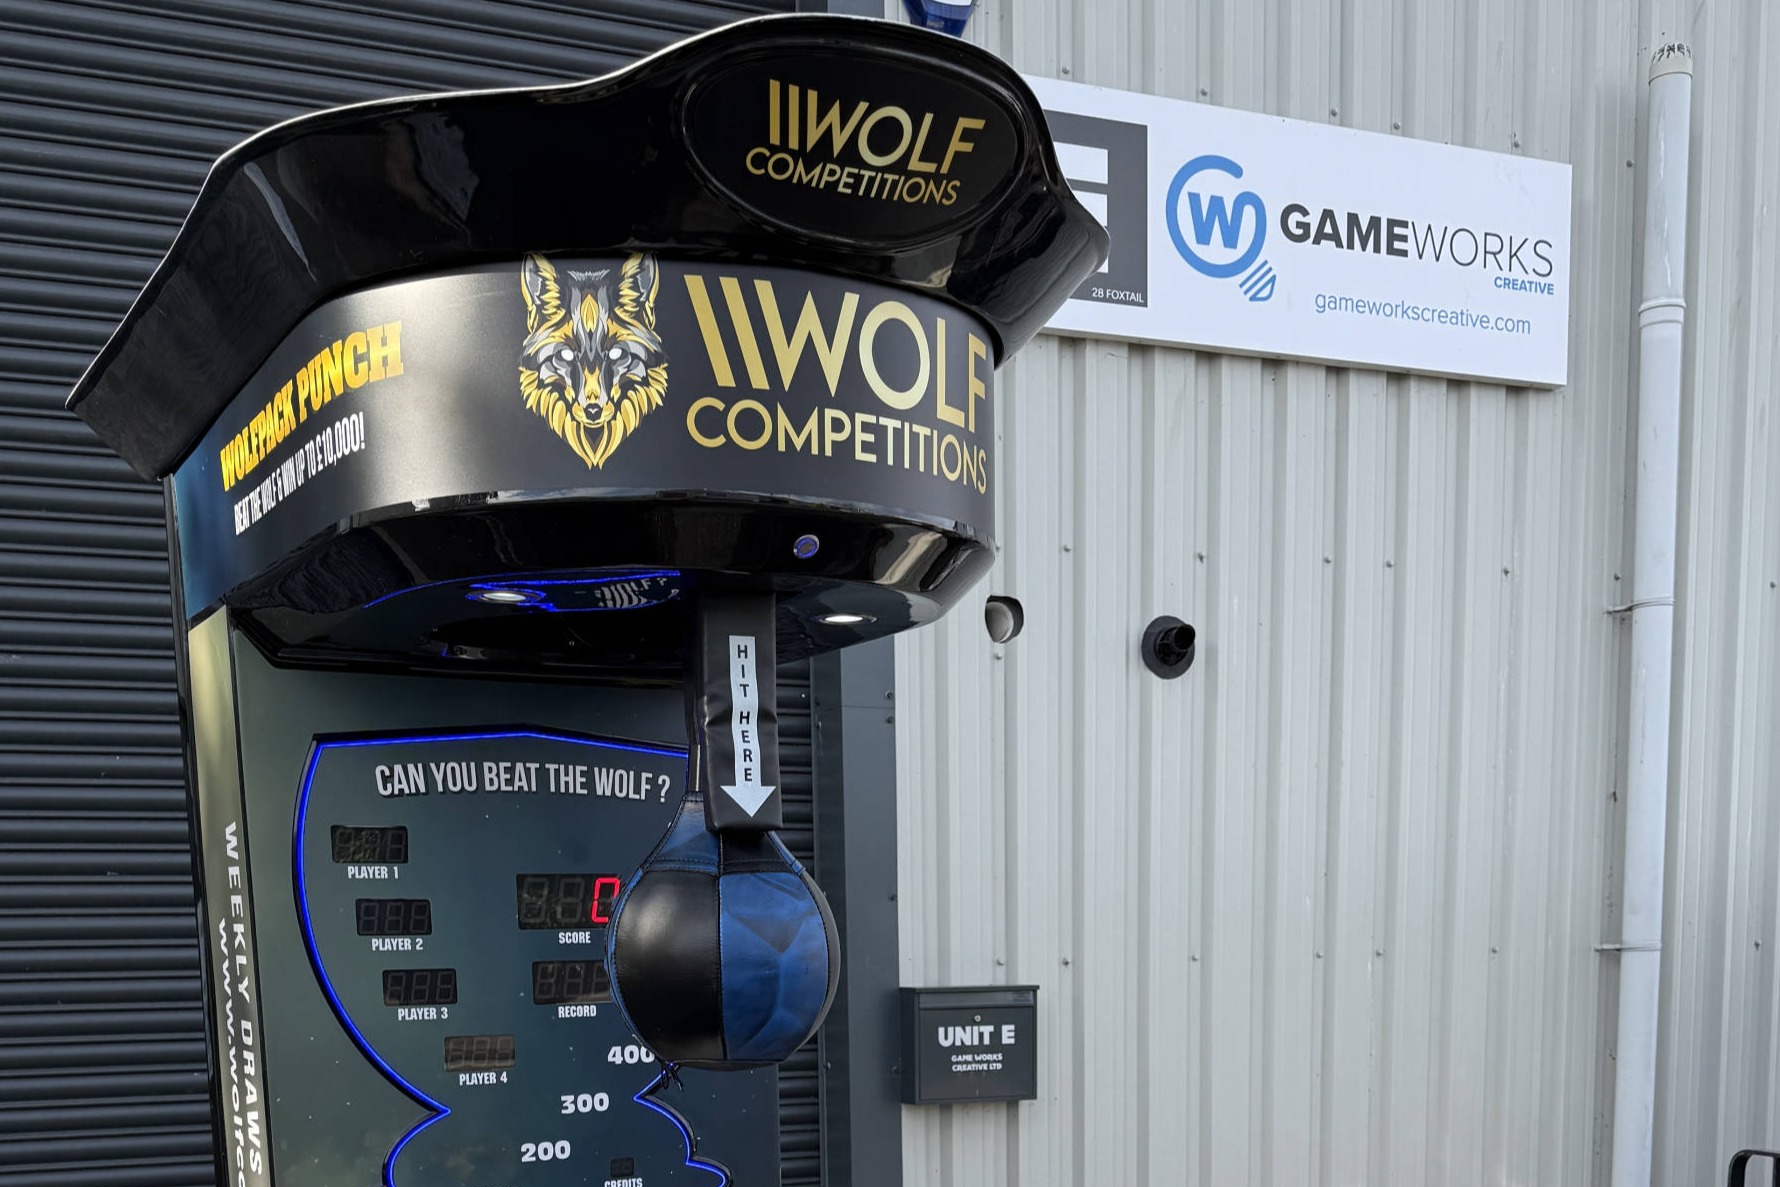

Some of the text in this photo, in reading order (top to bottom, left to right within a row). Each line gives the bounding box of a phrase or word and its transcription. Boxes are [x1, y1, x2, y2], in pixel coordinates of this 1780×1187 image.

[807, 89, 985, 174] WOLF
[746, 147, 961, 205] COMPETITIONS
[1280, 203, 1553, 277] GAMEWORKS
[1092, 287, 1145, 303] 28 FOXTAIL
[1494, 275, 1554, 296] CREATIVE
[1315, 291, 1531, 335] gameworkscreative.com
[753, 279, 986, 433] WOLF
[220, 319, 404, 492] WOLFPACK PUNCH
[687, 397, 987, 494] COMPETITIONS
[234, 496, 250, 536] BEAT
[249, 486, 262, 524] THE
[260, 471, 276, 515] WOLF
[281, 456, 296, 498] WIN
[295, 448, 306, 487] UP
[305, 439, 316, 479] TO
[316, 411, 365, 472] £10,000!
[736, 643, 749, 698] HIT
[738, 711, 753, 783] HERE
[375, 761, 671, 802] CAN YOU BEAT THE WOLF ?
[347, 866, 399, 880] PLAYER 1
[371, 938, 424, 951] PLAYER 2
[558, 932, 591, 944] SCORE
[225, 821, 250, 1003] WEEKLY
[240, 1019, 262, 1176] DRAWS
[397, 1007, 448, 1021] PLAYER 3
[558, 1005, 597, 1018] RECORD
[938, 1024, 1015, 1047] UNIT E
[607, 1045, 655, 1064] 400
[951, 1053, 1003, 1062] GAME WORKS
[952, 1062, 1002, 1072] CREATIVE LTD
[459, 1071, 508, 1086] PLAYER 4
[560, 1092, 610, 1114] 300
[520, 1140, 571, 1162] 200
